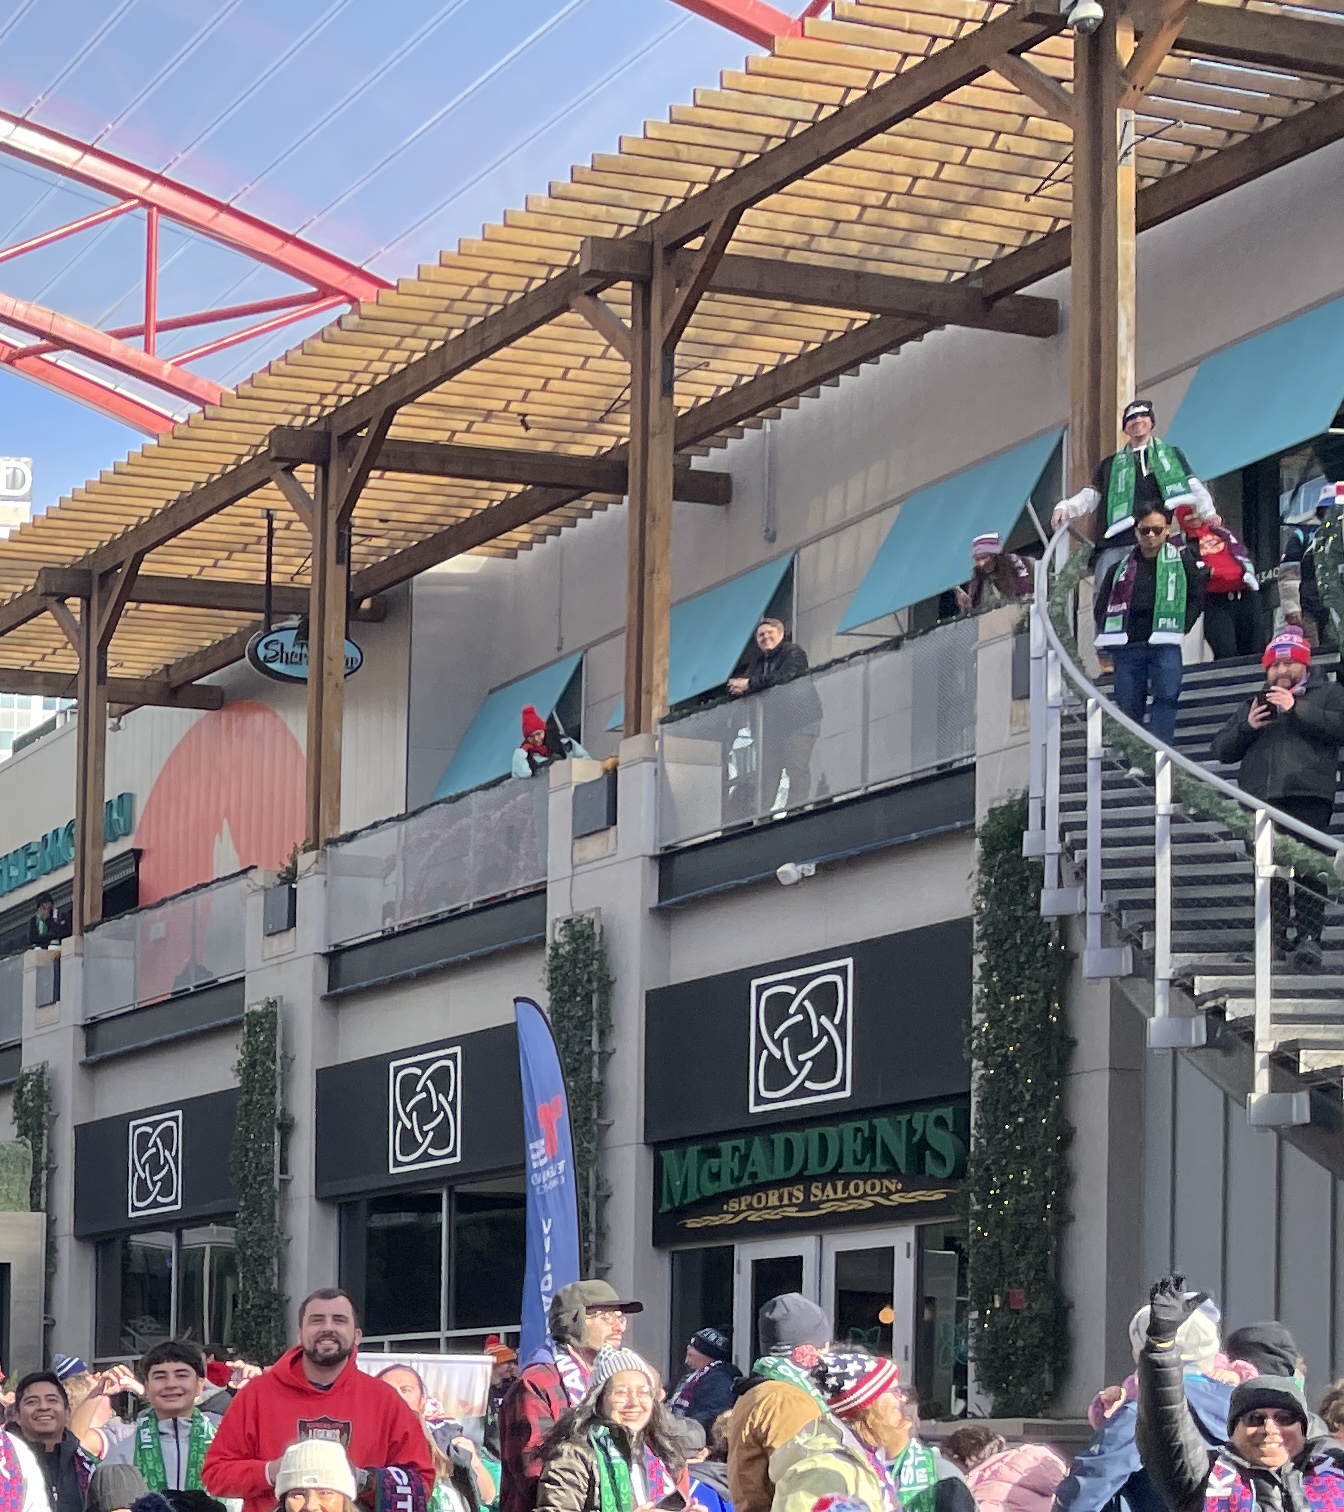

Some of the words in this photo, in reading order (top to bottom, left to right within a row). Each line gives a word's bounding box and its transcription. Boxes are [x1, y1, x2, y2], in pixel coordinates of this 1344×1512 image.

[658, 1106, 964, 1214] McFADDEN'S
[726, 1184, 803, 1213] SPORTS
[810, 1178, 899, 1202] SALOON
